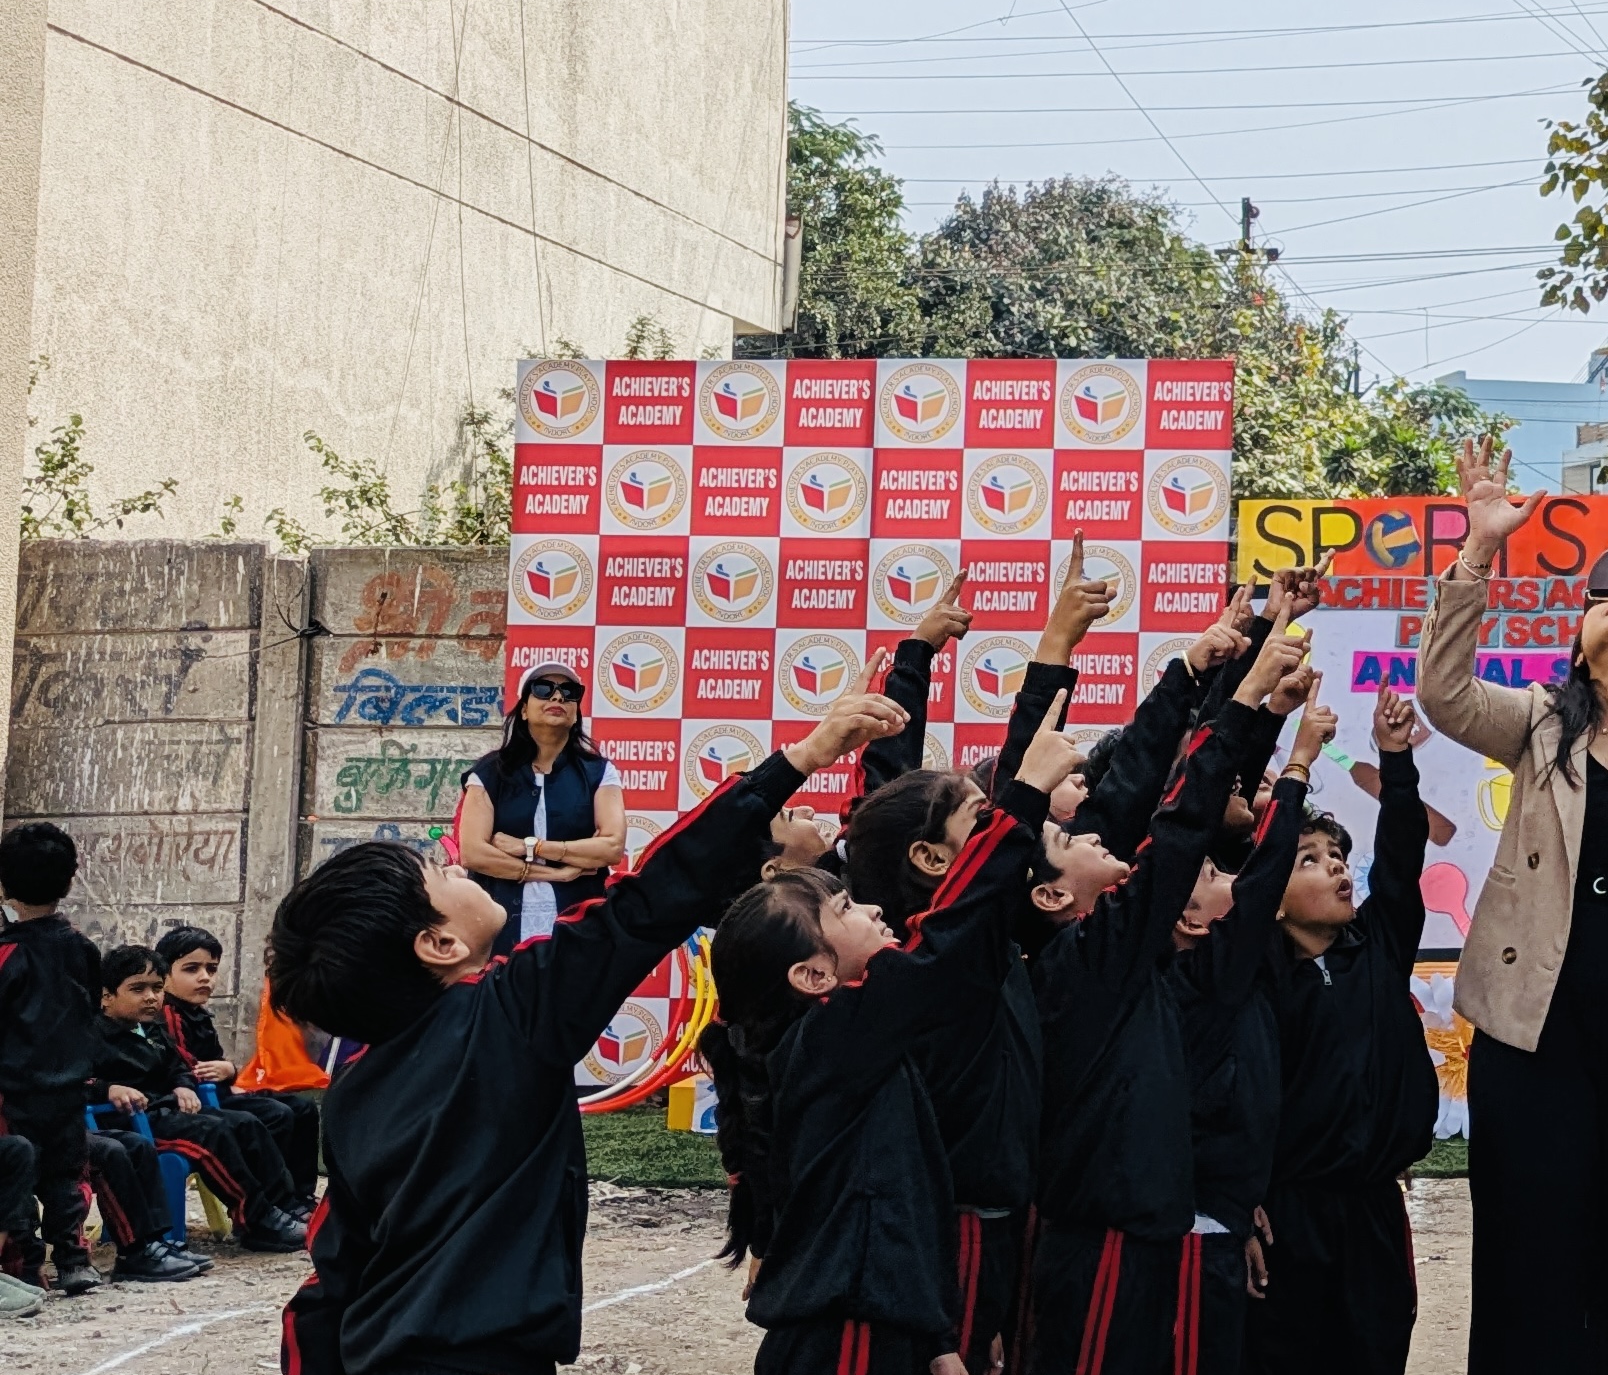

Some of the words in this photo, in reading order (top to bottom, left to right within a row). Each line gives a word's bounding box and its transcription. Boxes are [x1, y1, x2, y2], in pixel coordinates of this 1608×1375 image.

[613, 377, 690, 397] ACHIEVER'S
[793, 379, 870, 399] ACHIEVER'S
[973, 380, 1050, 400] ACHIEVER'S
[1154, 381, 1231, 402] ACHIEVER'S
[619, 405, 682, 425] ACADEMY
[799, 408, 862, 427] ACADEMY
[979, 409, 1043, 428] ACADEMY
[1160, 410, 1224, 430] ACADEMY
[520, 466, 596, 486] ACHIEVER'S
[699, 468, 776, 488] ACHIEVER'S
[880, 470, 957, 490] ACHIEVER'S
[1060, 471, 1138, 491] ACHIEVER'S
[526, 494, 589, 514] ACADEMY
[705, 496, 769, 516] ACADEMY
[886, 499, 950, 519] ACADEMY
[1067, 500, 1130, 520] ACADEMY
[606, 557, 683, 578] ACHIEVER'S
[786, 560, 863, 580] ACHIEVER'S
[964, 562, 1044, 582] ACHIEVER'S
[1148, 563, 1226, 583] ACHIEVER'S
[611, 586, 675, 606] ACADEMY
[792, 589, 855, 608] ACADEMY
[973, 591, 1037, 612] ACADEMY
[1153, 593, 1219, 613] ACADEMY
[692, 649, 769, 670] ACHIEVER'S
[697, 679, 761, 699] ACADEMY
[1070, 683, 1125, 704] CADEMY
[616, 770, 668, 790] ADEMY
[795, 773, 849, 793] ADEMY
